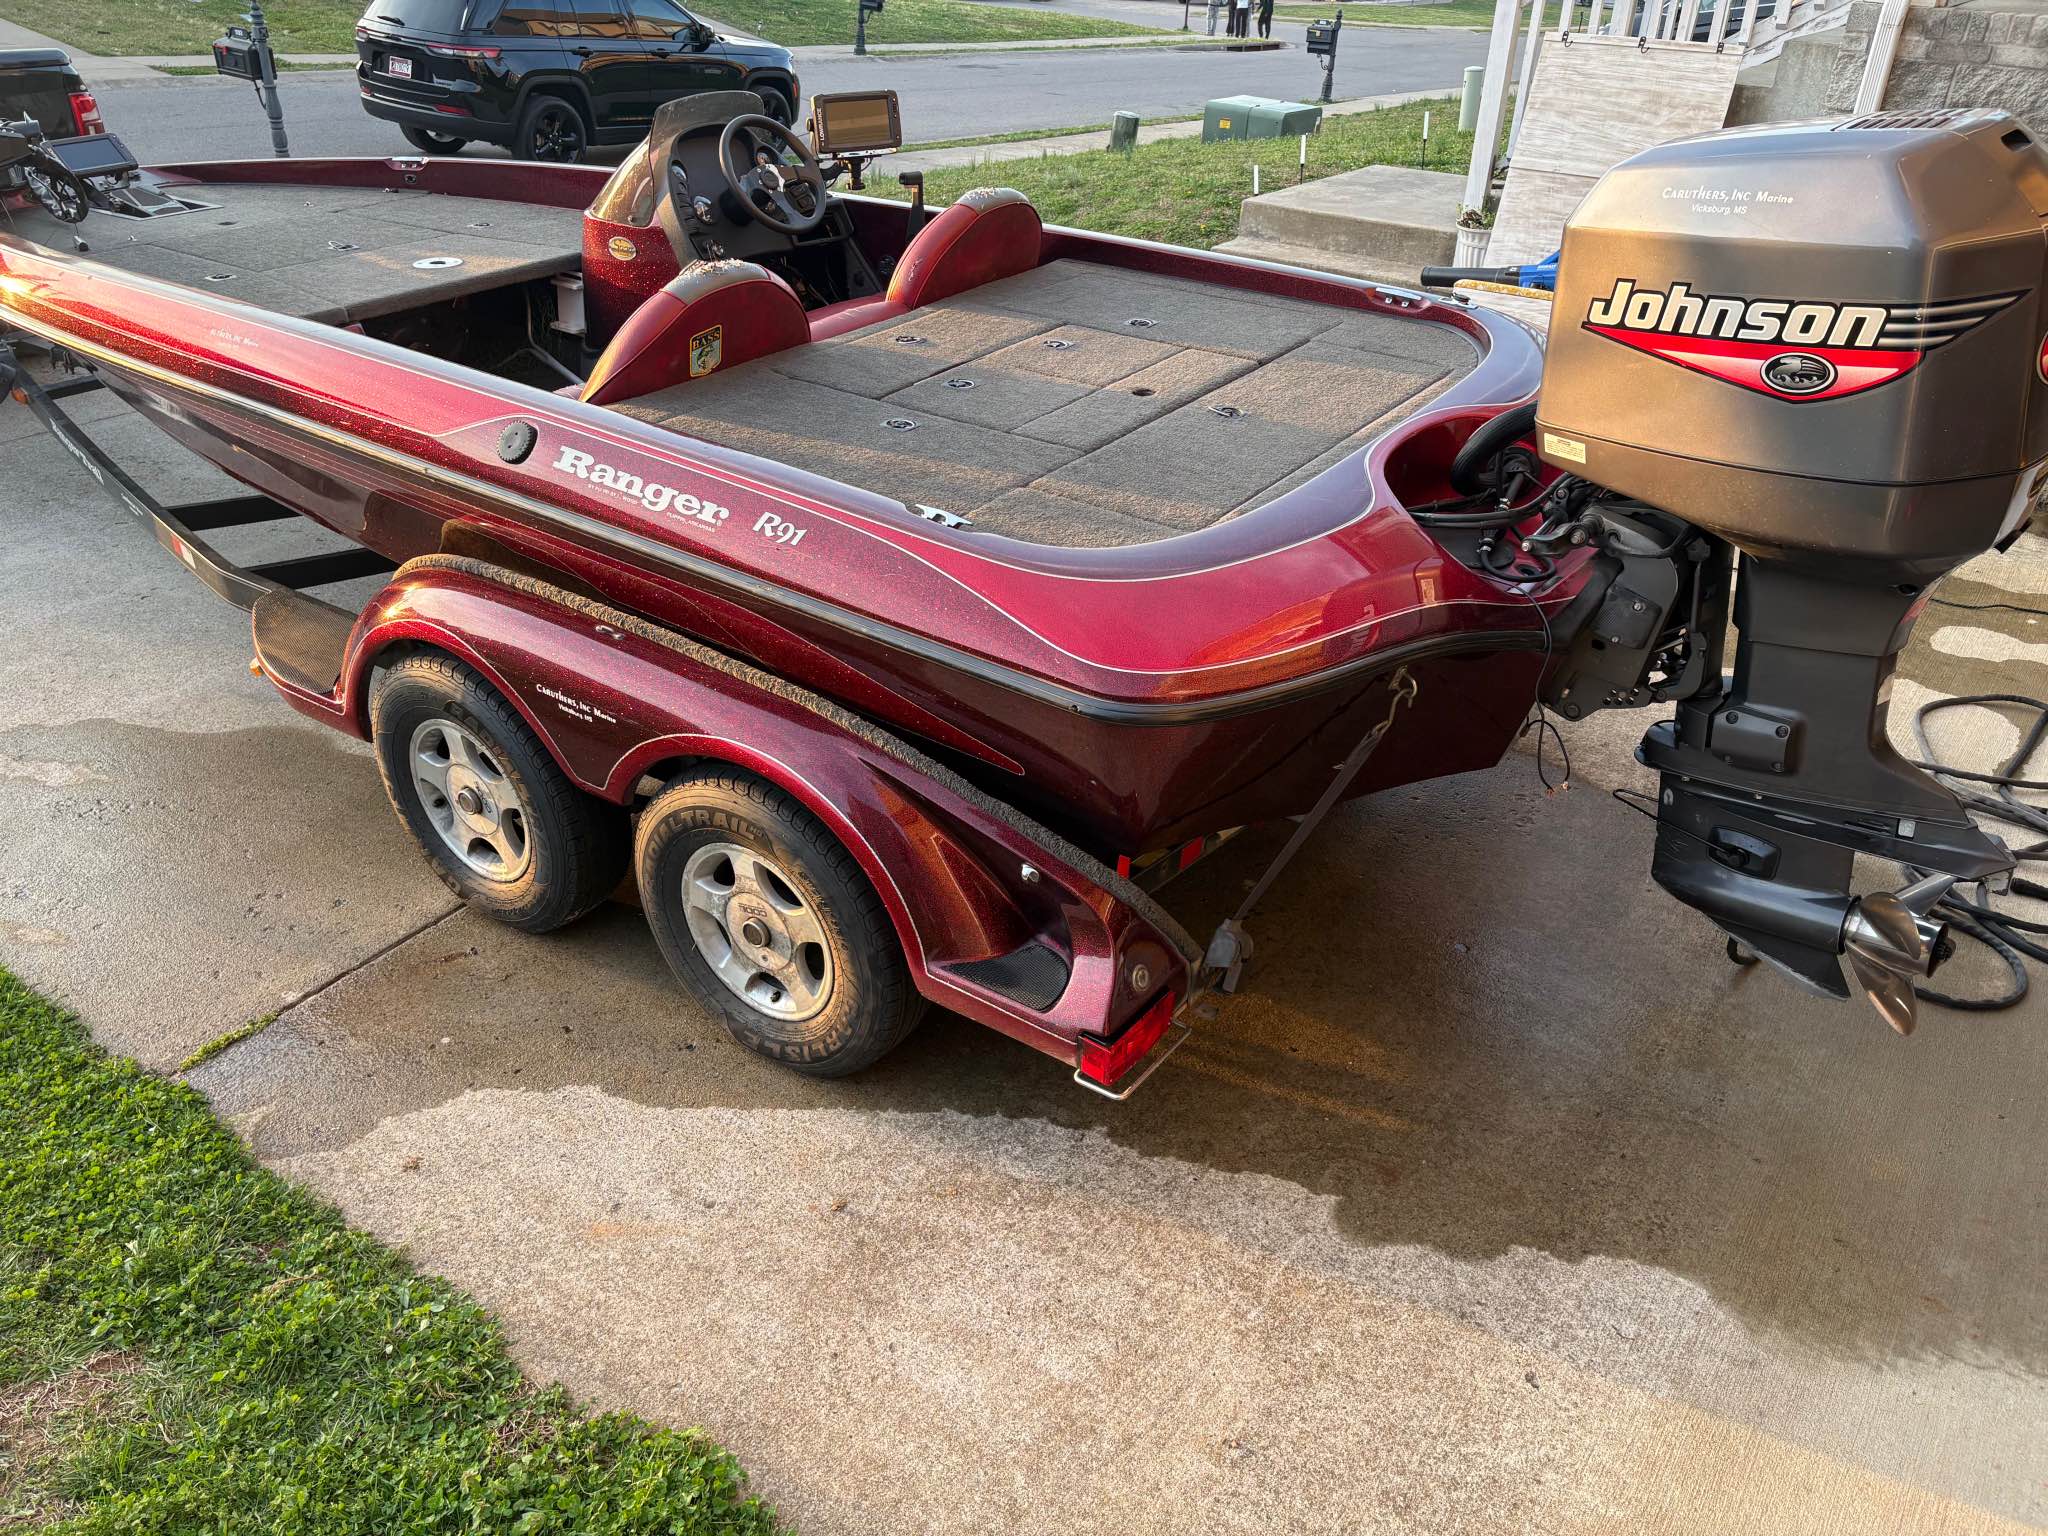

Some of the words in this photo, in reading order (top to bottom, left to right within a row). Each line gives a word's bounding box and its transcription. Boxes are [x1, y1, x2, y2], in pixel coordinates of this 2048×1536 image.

[816, 107, 825, 141] LOWRANCE
[1731, 189, 1751, 201] INC
[1755, 191, 1794, 204] Marine
[1733, 206, 1748, 215] MS
[1587, 278, 1890, 348] Johnson
[552, 445, 730, 527] Ranger
[752, 511, 808, 546] R91
[593, 706, 617, 724] Marine
